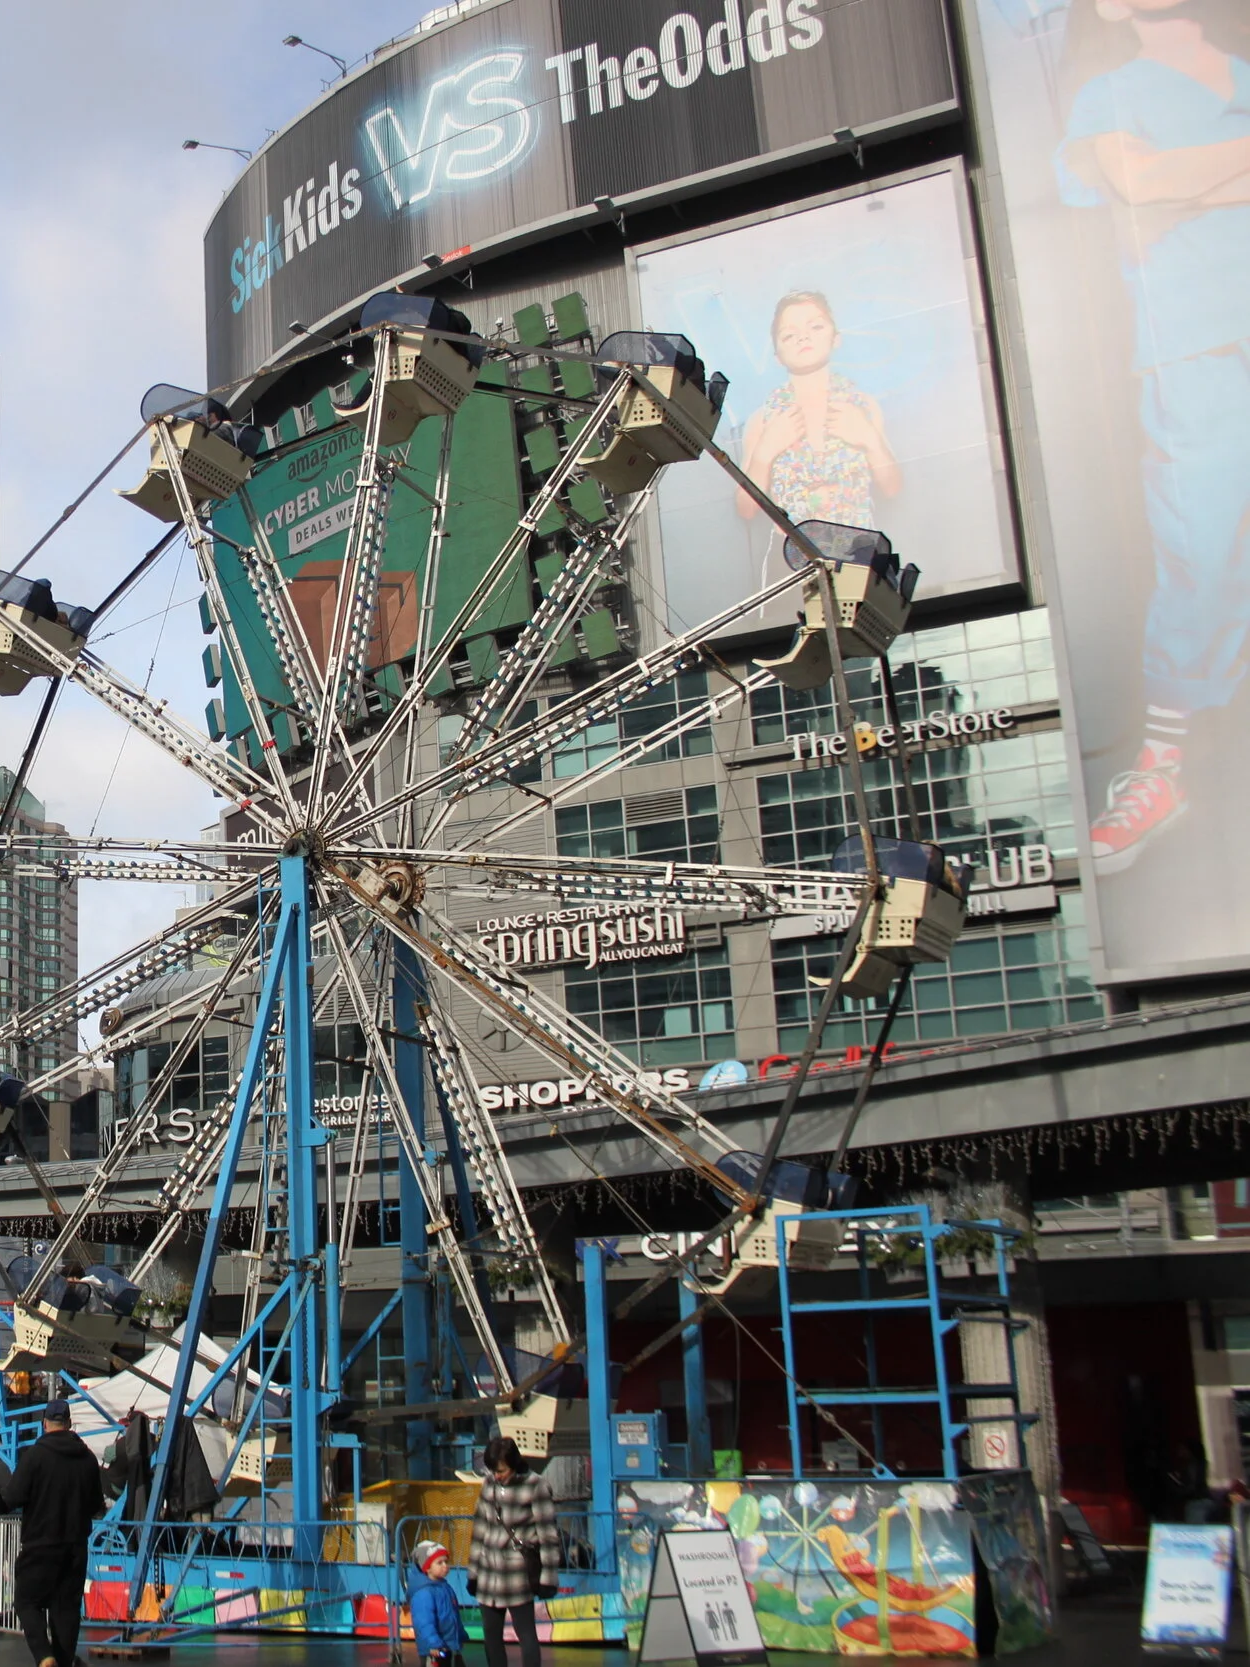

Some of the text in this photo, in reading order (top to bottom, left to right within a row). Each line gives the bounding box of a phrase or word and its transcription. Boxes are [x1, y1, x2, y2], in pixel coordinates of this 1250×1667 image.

[231, 161, 363, 313] SickKids
[264, 486, 321, 536] CYBER
[295, 500, 363, 544] DEALS WEE
[785, 708, 1014, 761] The Beer Store
[477, 902, 646, 933] LOUNGE RESTAURANT
[480, 1069, 690, 1109] SHOPRS
[321, 1115, 354, 1126] GRILL
[682, 1576, 715, 1588] Located
[717, 1576, 725, 1586] in
